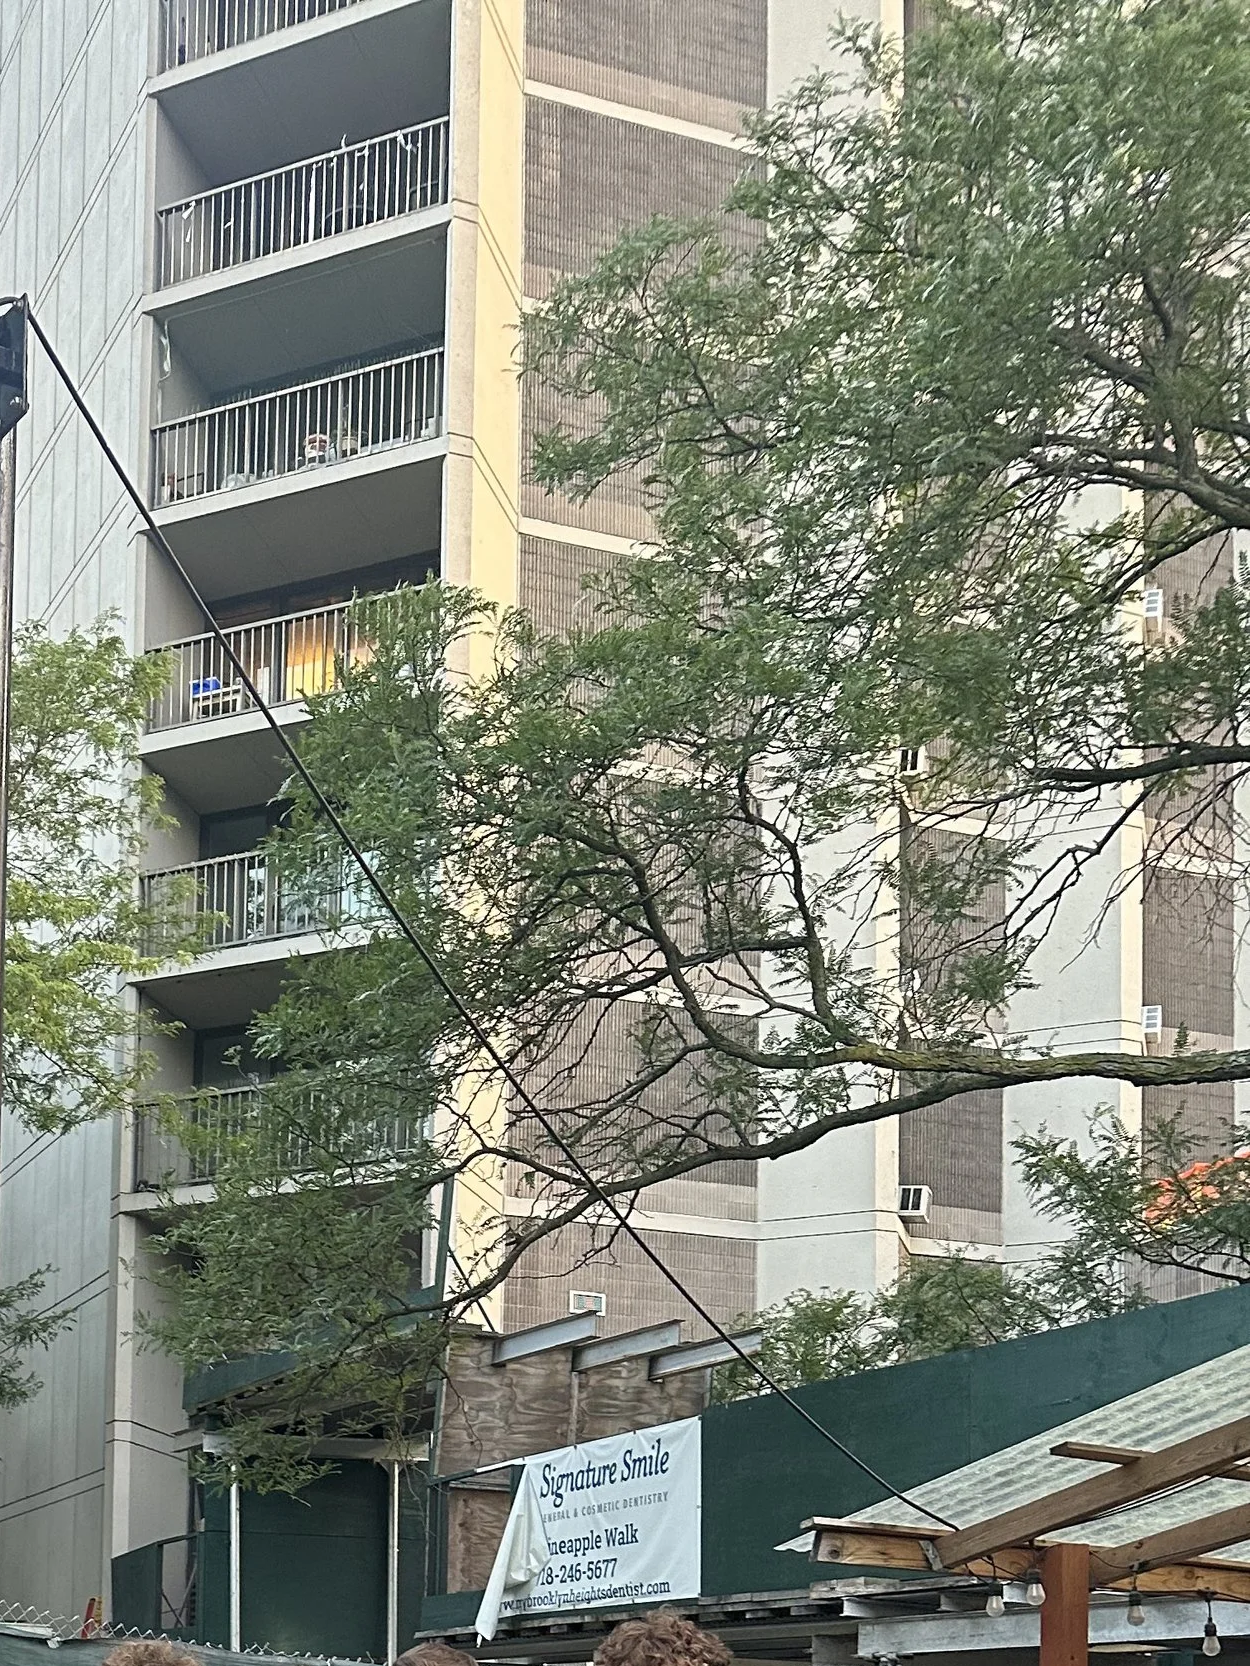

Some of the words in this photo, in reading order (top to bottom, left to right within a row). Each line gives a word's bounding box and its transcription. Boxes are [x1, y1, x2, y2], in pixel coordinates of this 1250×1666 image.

[540, 1460, 617, 1508] Signature
[621, 1438, 670, 1482] Smile
[542, 1509, 571, 1523] ENERAL
[573, 1507, 579, 1518] &
[581, 1500, 620, 1517] COSMETIC
[622, 1491, 669, 1509] DENTISTRY
[547, 1529, 602, 1558] ineapple
[605, 1522, 639, 1548] Walk
